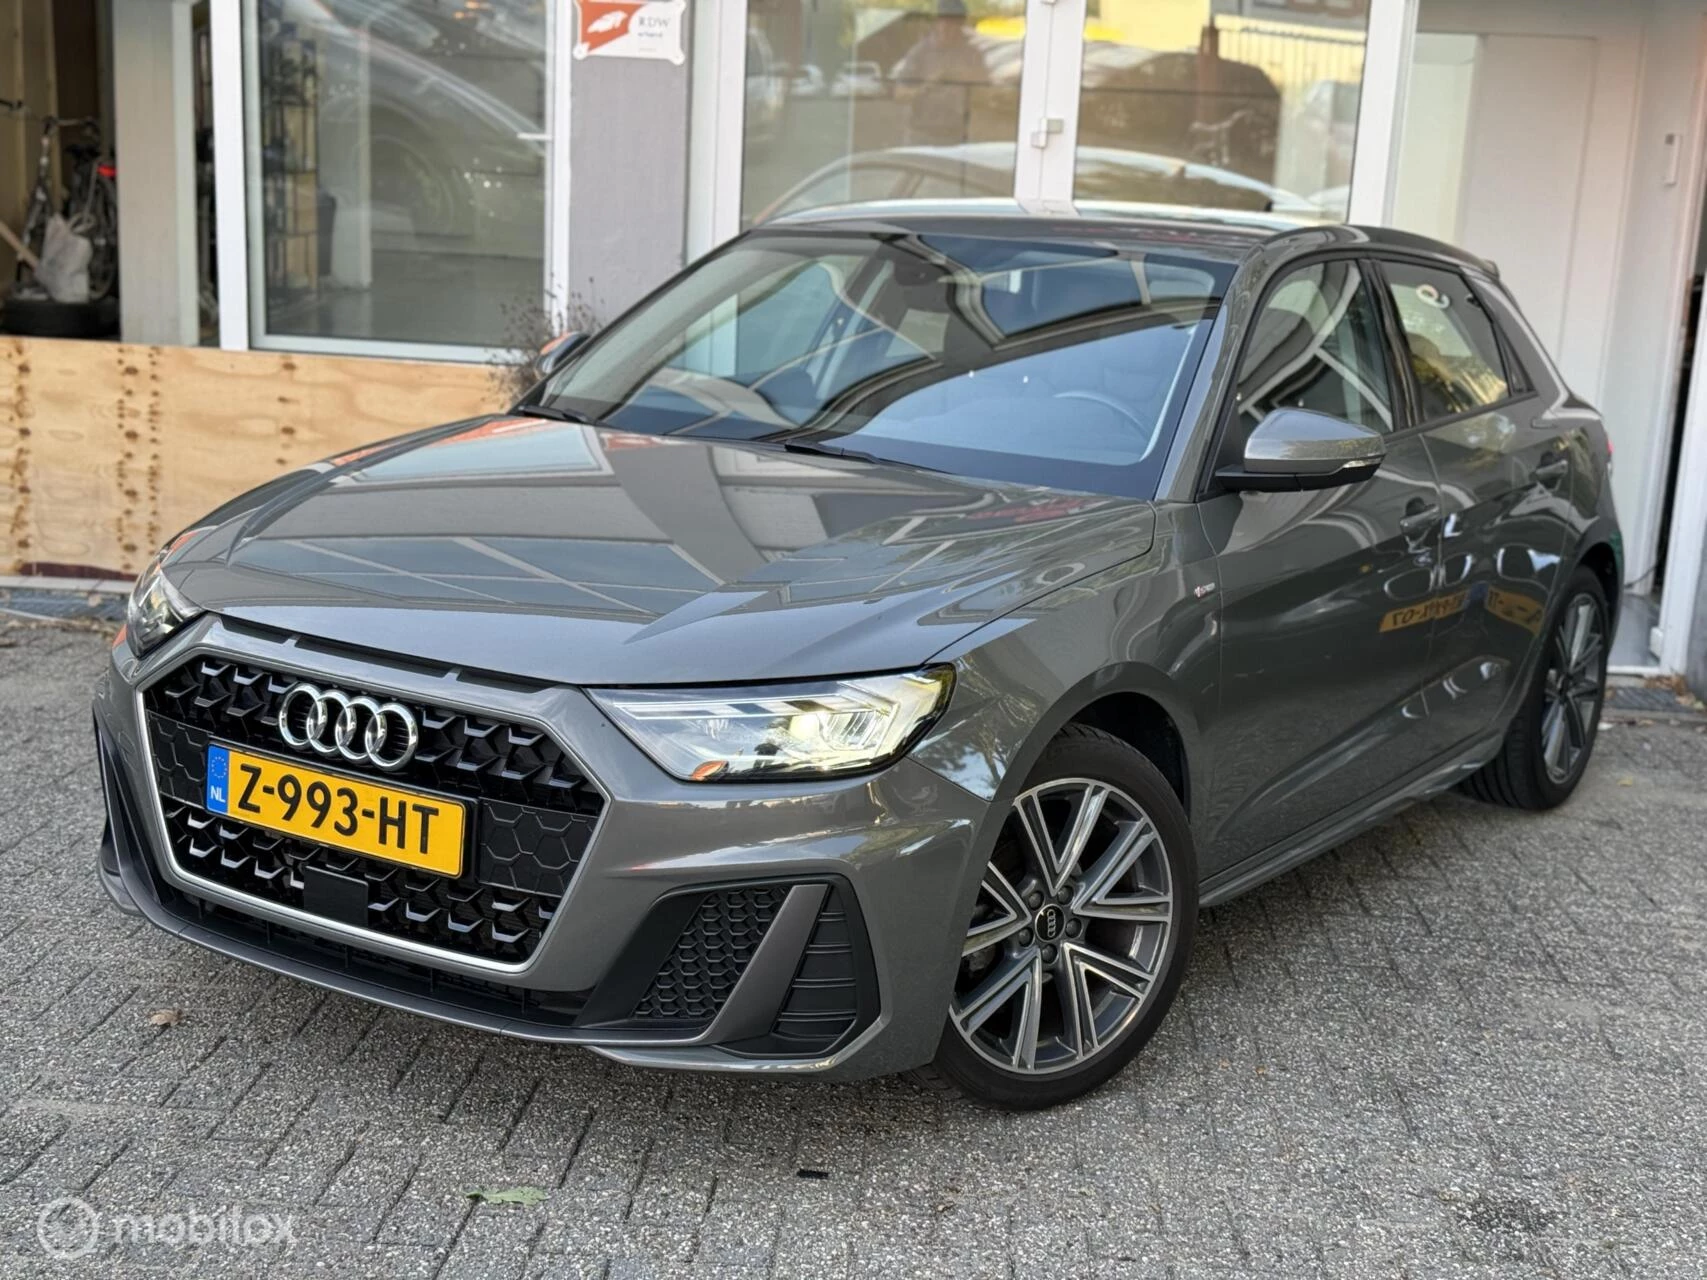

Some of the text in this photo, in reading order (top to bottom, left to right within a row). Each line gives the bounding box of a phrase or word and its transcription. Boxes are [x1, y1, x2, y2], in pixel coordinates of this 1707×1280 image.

[638, 16, 671, 28] RDW
[210, 785, 226, 803] NL
[238, 763, 439, 854] Z-993-HT
